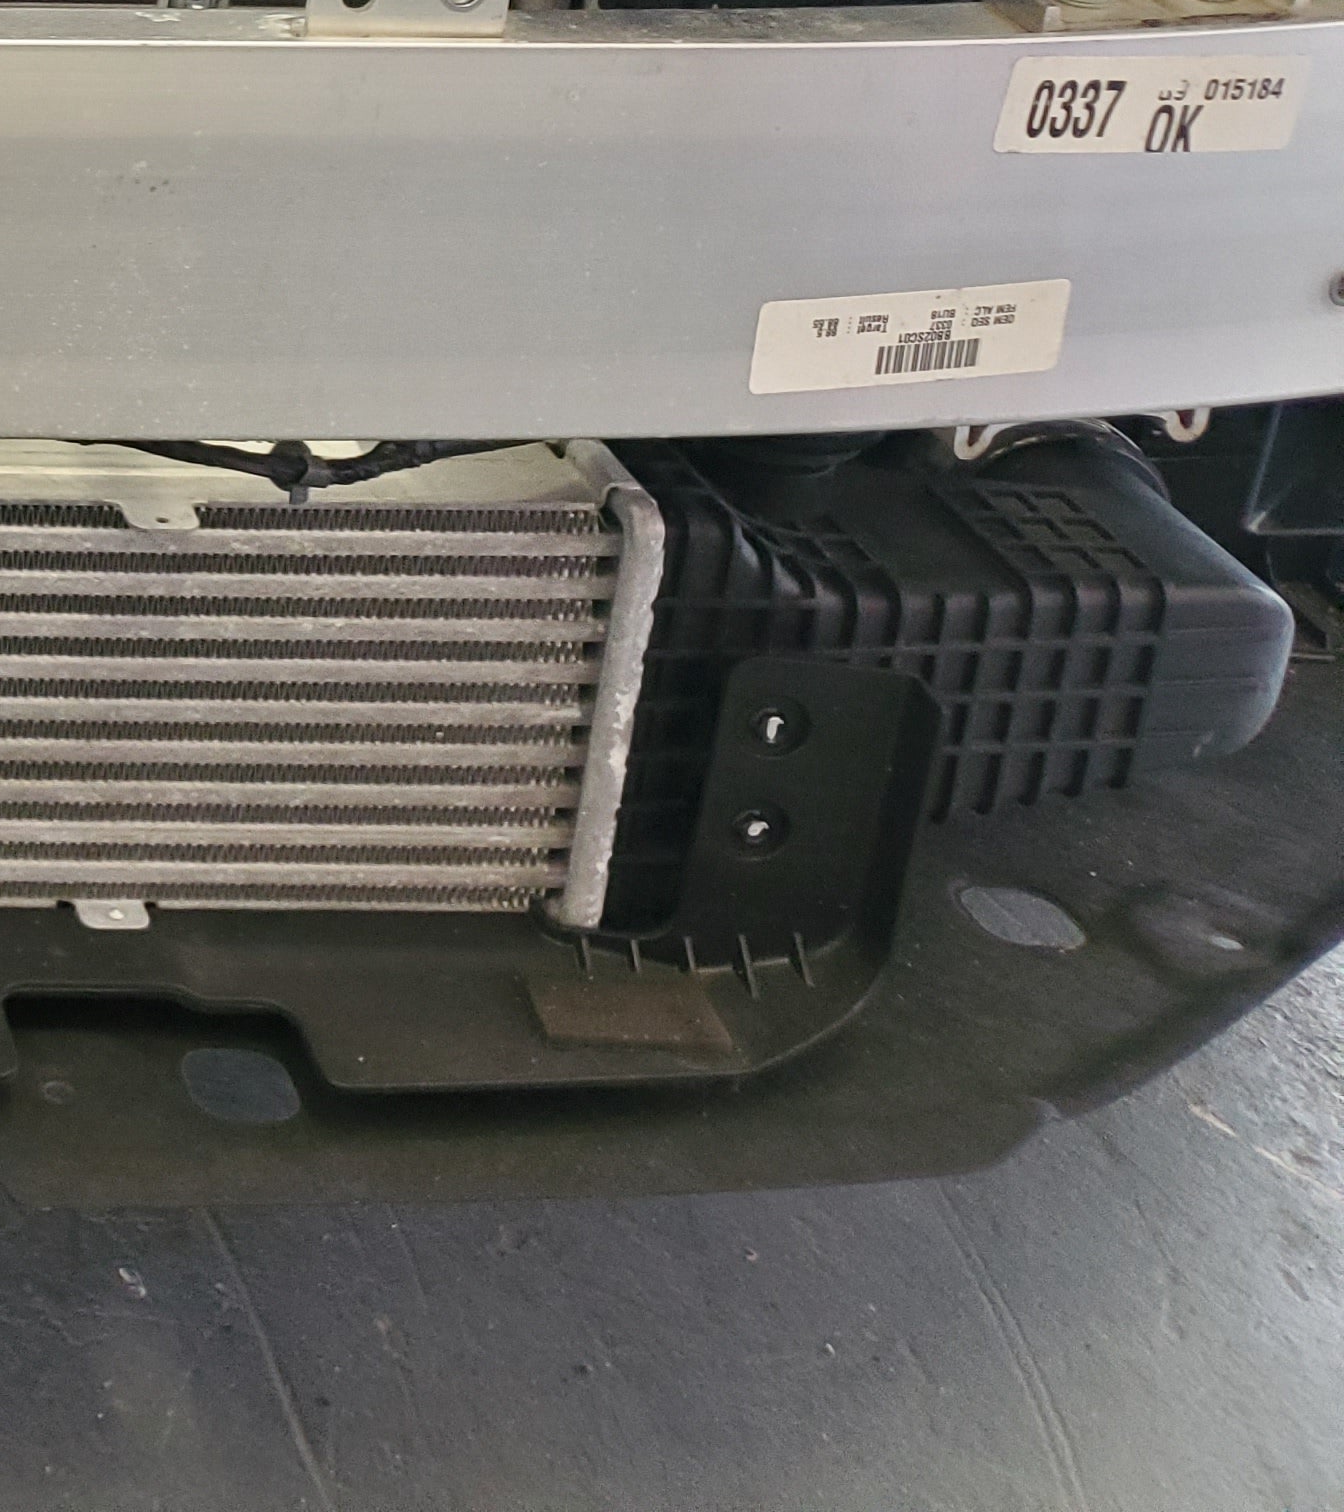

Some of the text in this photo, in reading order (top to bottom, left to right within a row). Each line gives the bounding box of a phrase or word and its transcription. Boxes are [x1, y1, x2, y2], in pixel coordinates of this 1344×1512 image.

[1026, 79, 1127, 138] 0337
[1204, 78, 1285, 100] 015184
[1145, 104, 1204, 153] OK
[974, 306, 994, 316] ALC
[856, 323, 888, 335] Target
